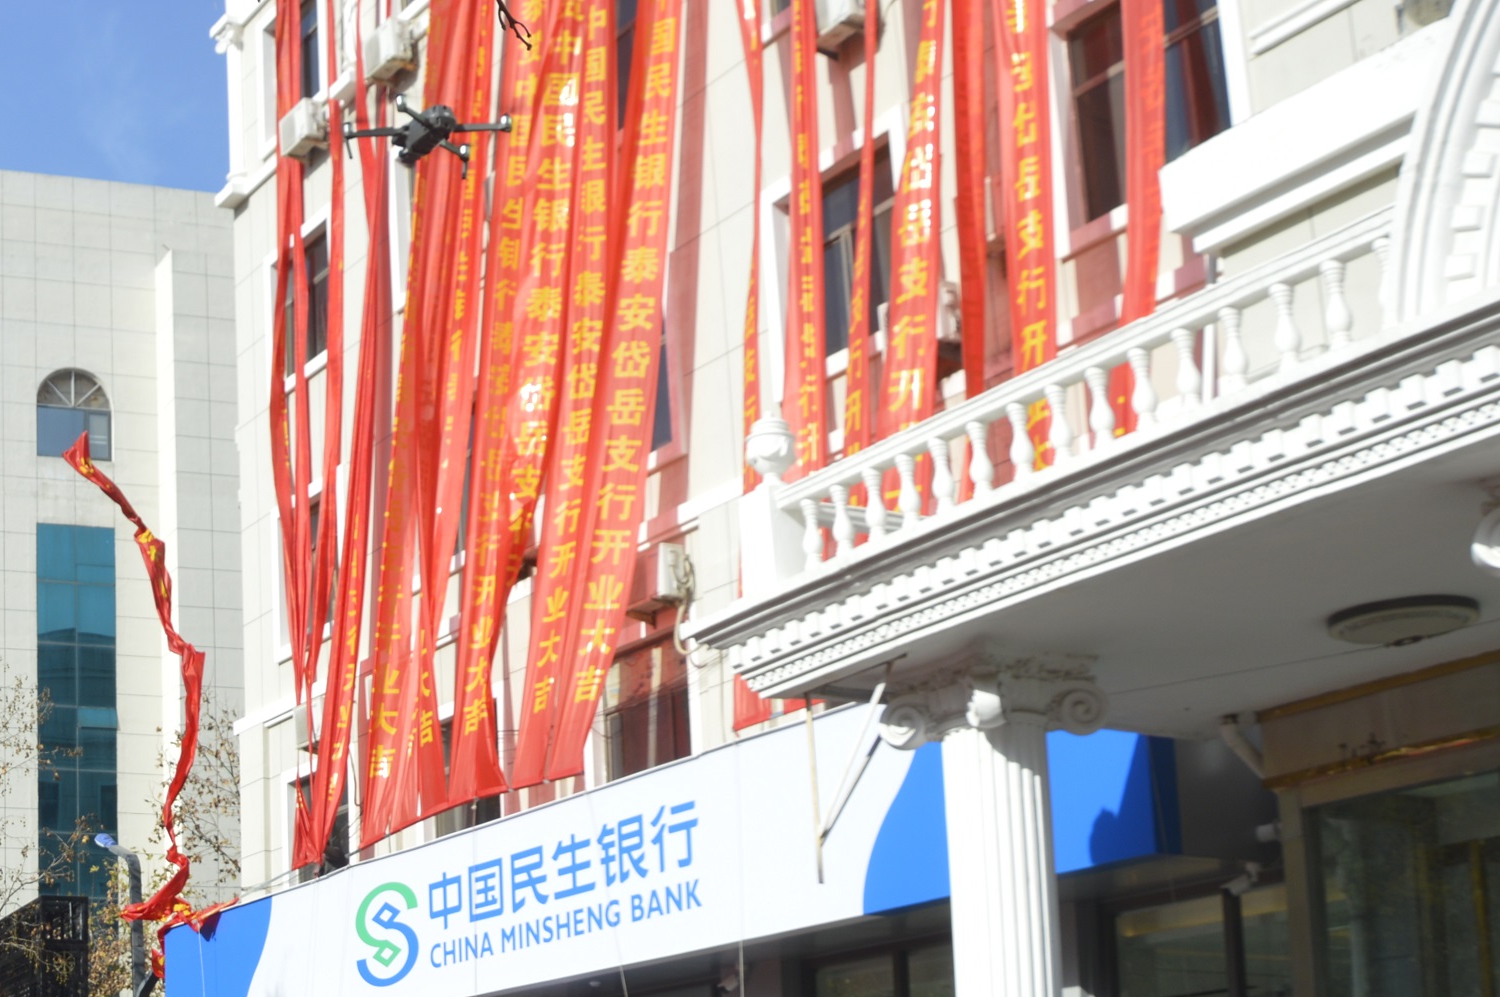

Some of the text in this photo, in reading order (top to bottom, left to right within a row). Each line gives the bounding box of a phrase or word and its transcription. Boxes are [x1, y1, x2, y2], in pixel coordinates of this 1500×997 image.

[428, 800, 699, 930] 中国民生银行
[430, 879, 702, 969] CHINA MINSHENG BANK
